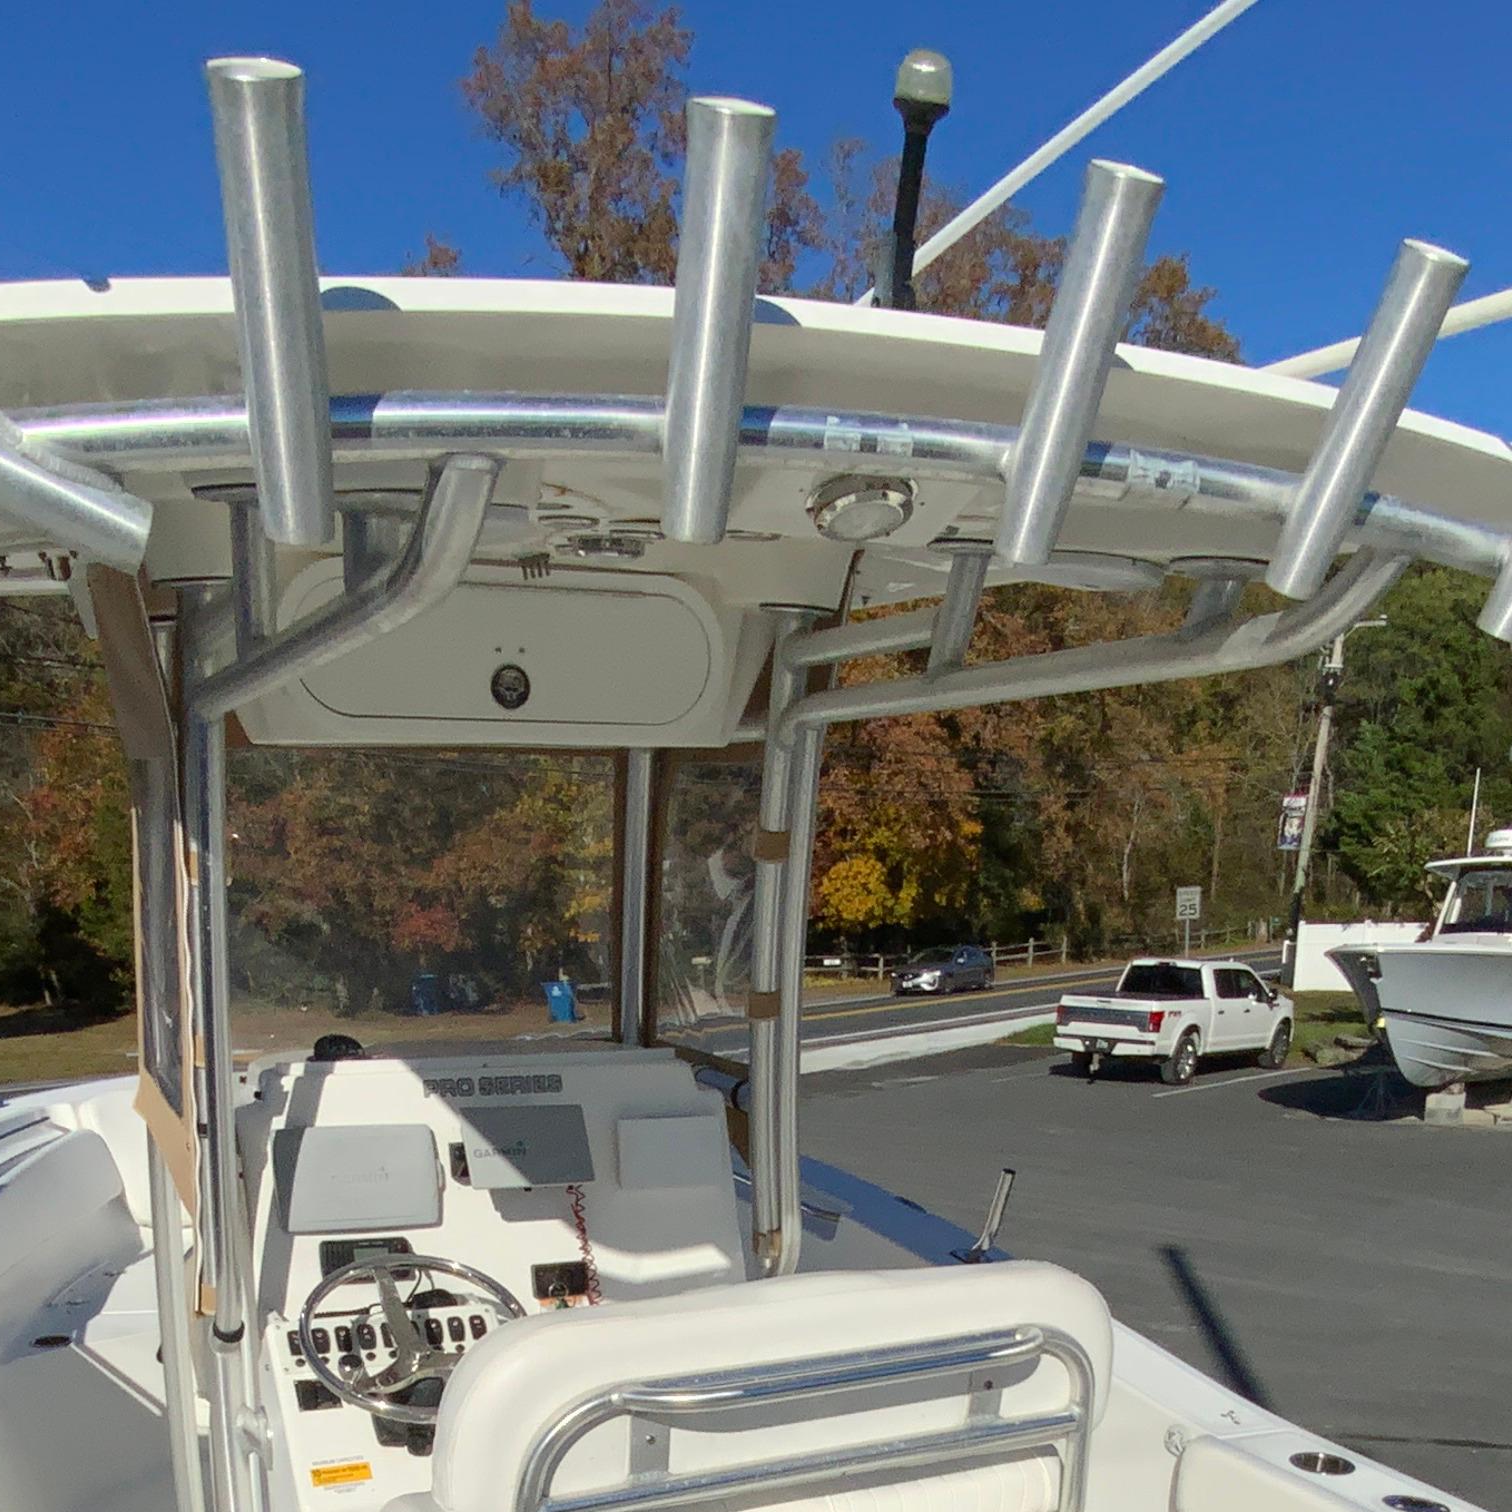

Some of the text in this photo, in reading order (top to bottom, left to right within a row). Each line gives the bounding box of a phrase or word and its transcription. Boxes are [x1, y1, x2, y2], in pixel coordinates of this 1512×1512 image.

[1179, 903, 1197, 916] 25
[423, 1074, 563, 1098] PRO SERIES
